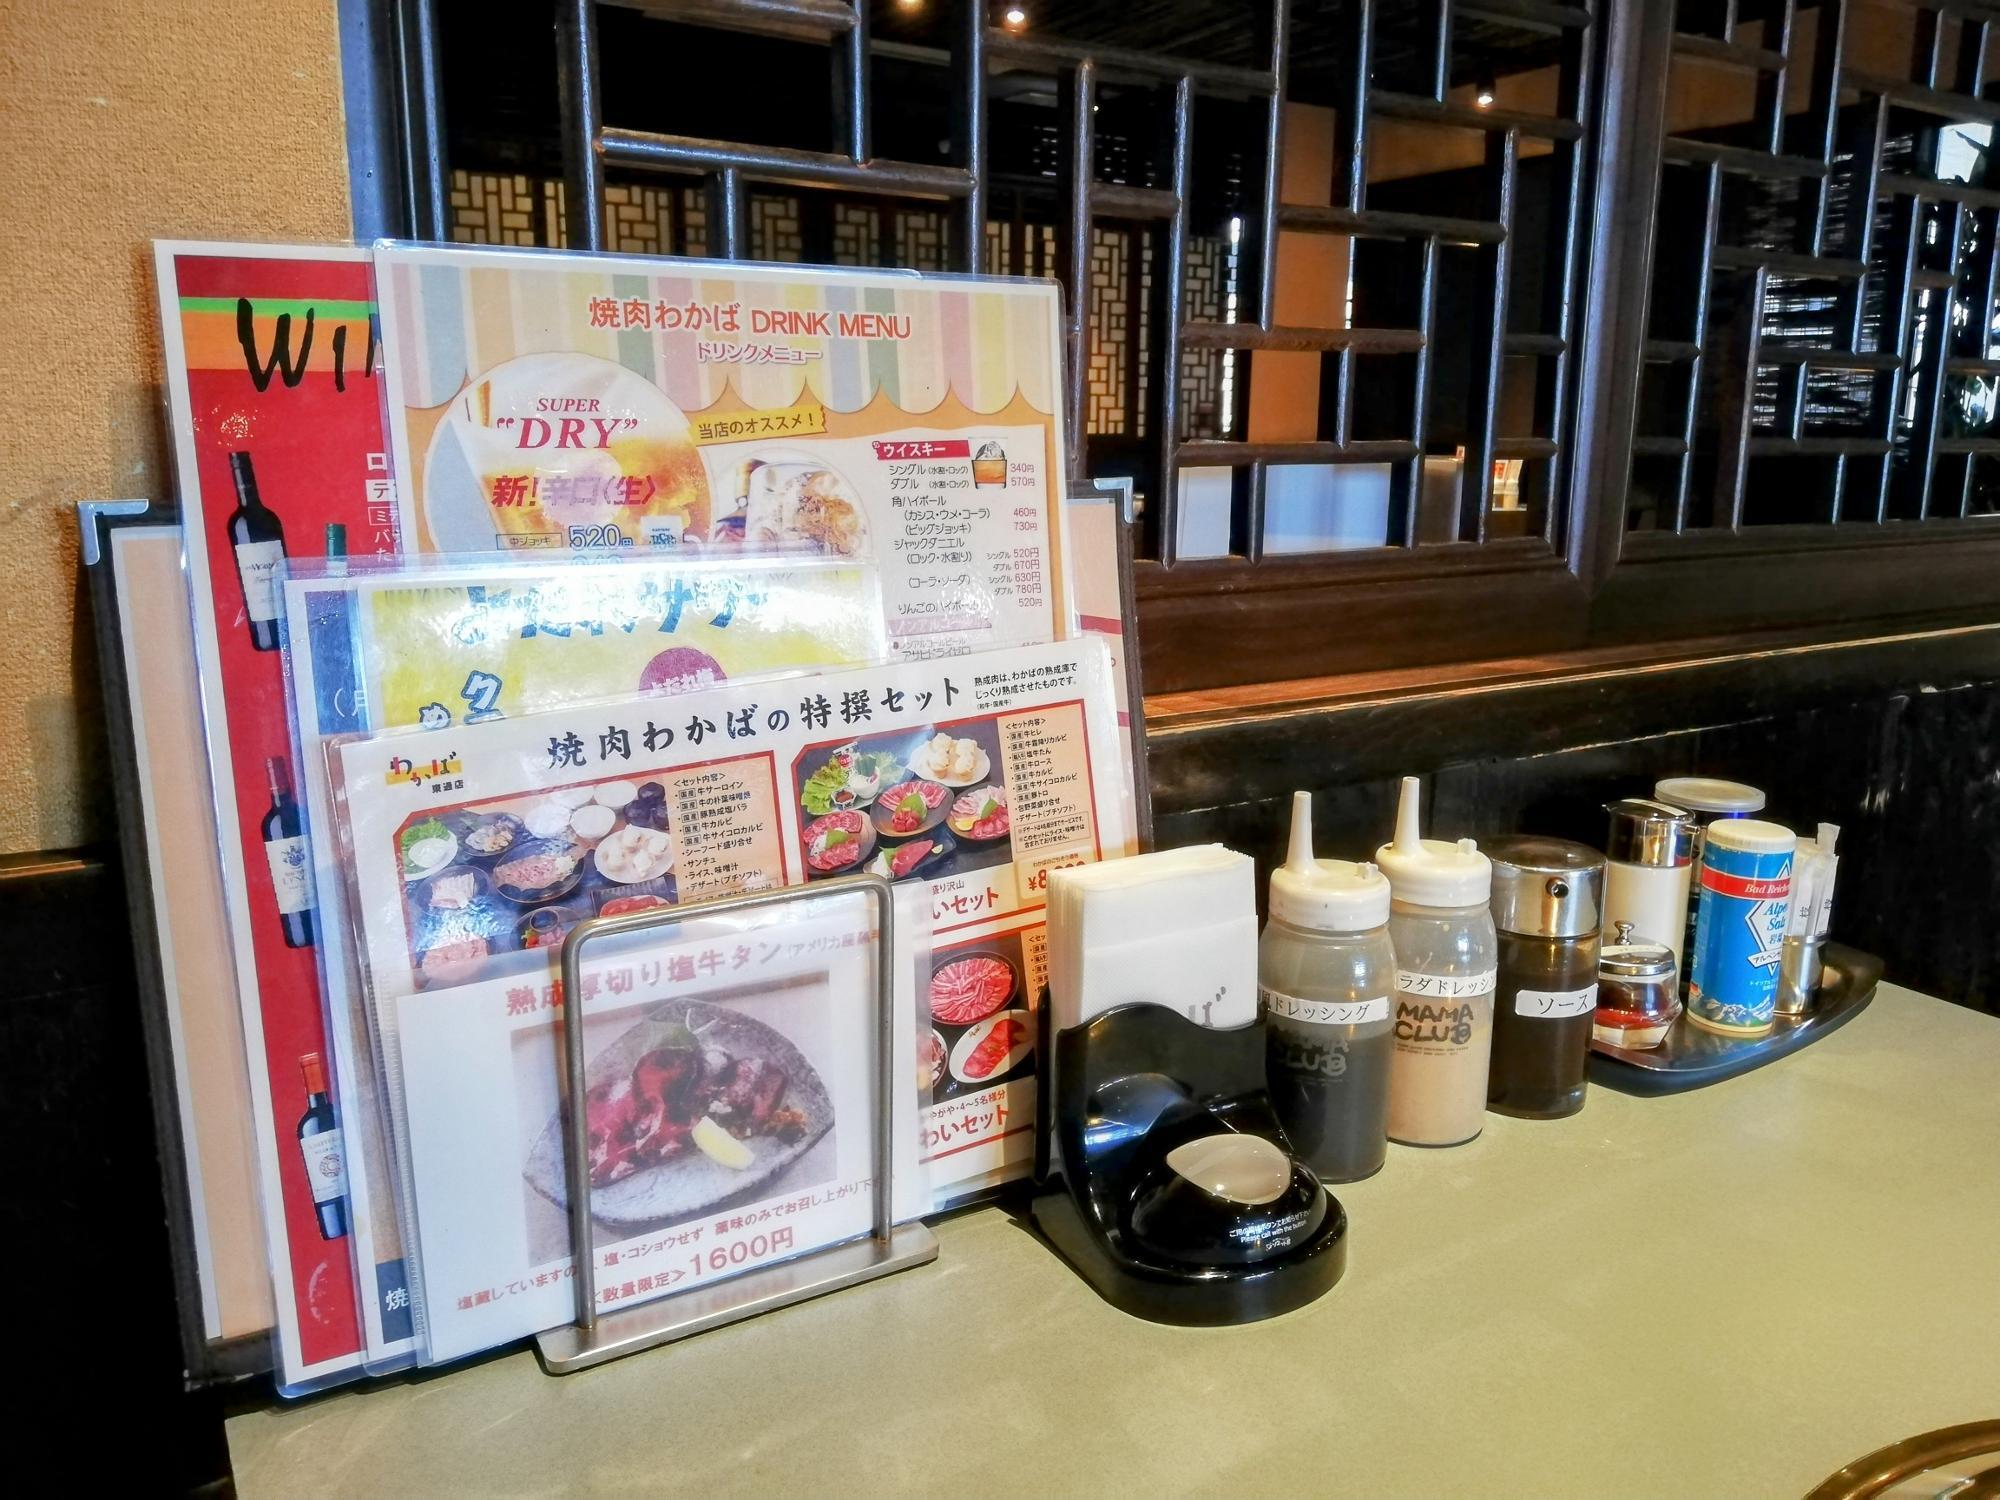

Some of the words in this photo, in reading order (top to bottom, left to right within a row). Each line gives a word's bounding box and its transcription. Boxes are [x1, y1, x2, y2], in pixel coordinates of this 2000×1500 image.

[589, 297, 741, 331] 焼肉わかば
[752, 309, 830, 337] DRINK
[839, 313, 911, 339] MENU
[698, 342, 821, 364] ドリンクメニュー
[537, 398, 600, 412] SUPER
[699, 413, 813, 439] 当店のオススメ！
[883, 443, 946, 457] ウイスキー
[889, 464, 925, 475] シングル
[1011, 463, 1034, 473] 340円
[890, 479, 919, 490] ダブル
[1011, 478, 1035, 487] 570円
[892, 495, 946, 508] 角ハイボール
[1014, 508, 1037, 517] 460円
[1014, 522, 1038, 531] 730円
[509, 537, 551, 547] 中ジョッキ
[894, 538, 965, 551] ジャックダニエル
[986, 552, 1011, 560] シングル
[1014, 547, 1039, 558] 520円
[993, 563, 1012, 571] ダブル
[1014, 559, 1040, 570] 670円
[988, 575, 1013, 584] シングル
[1015, 571, 1041, 582] 630円
[994, 587, 1013, 595] ダブル
[1016, 583, 1042, 594] 780円
[1018, 598, 1042, 607] 520円
[547, 677, 959, 770] 焼肉わかばの特撰セット
[1024, 729, 1042, 737] 牛ヒレ
[1028, 758, 1052, 768] 牛ロース
[1029, 767, 1053, 778] 牛カルビ
[1030, 772, 1077, 788] 牛サイコロカルビ
[697, 781, 744, 796] 牛サーロイン
[701, 817, 733, 830] 牛カルビ
[703, 823, 763, 841] 牛サイコロカルビ
[1745, 883, 1765, 894] Bad
[1538, 994, 1588, 1015] ソース
[1396, 1001, 1474, 1023] MAMA
[1395, 1020, 1471, 1045] CLUB
[1241, 1234, 1260, 1243] Please
[1272, 1228, 1284, 1236] with
[1293, 1220, 1307, 1229] button
[690, 1226, 795, 1278] 1600円
